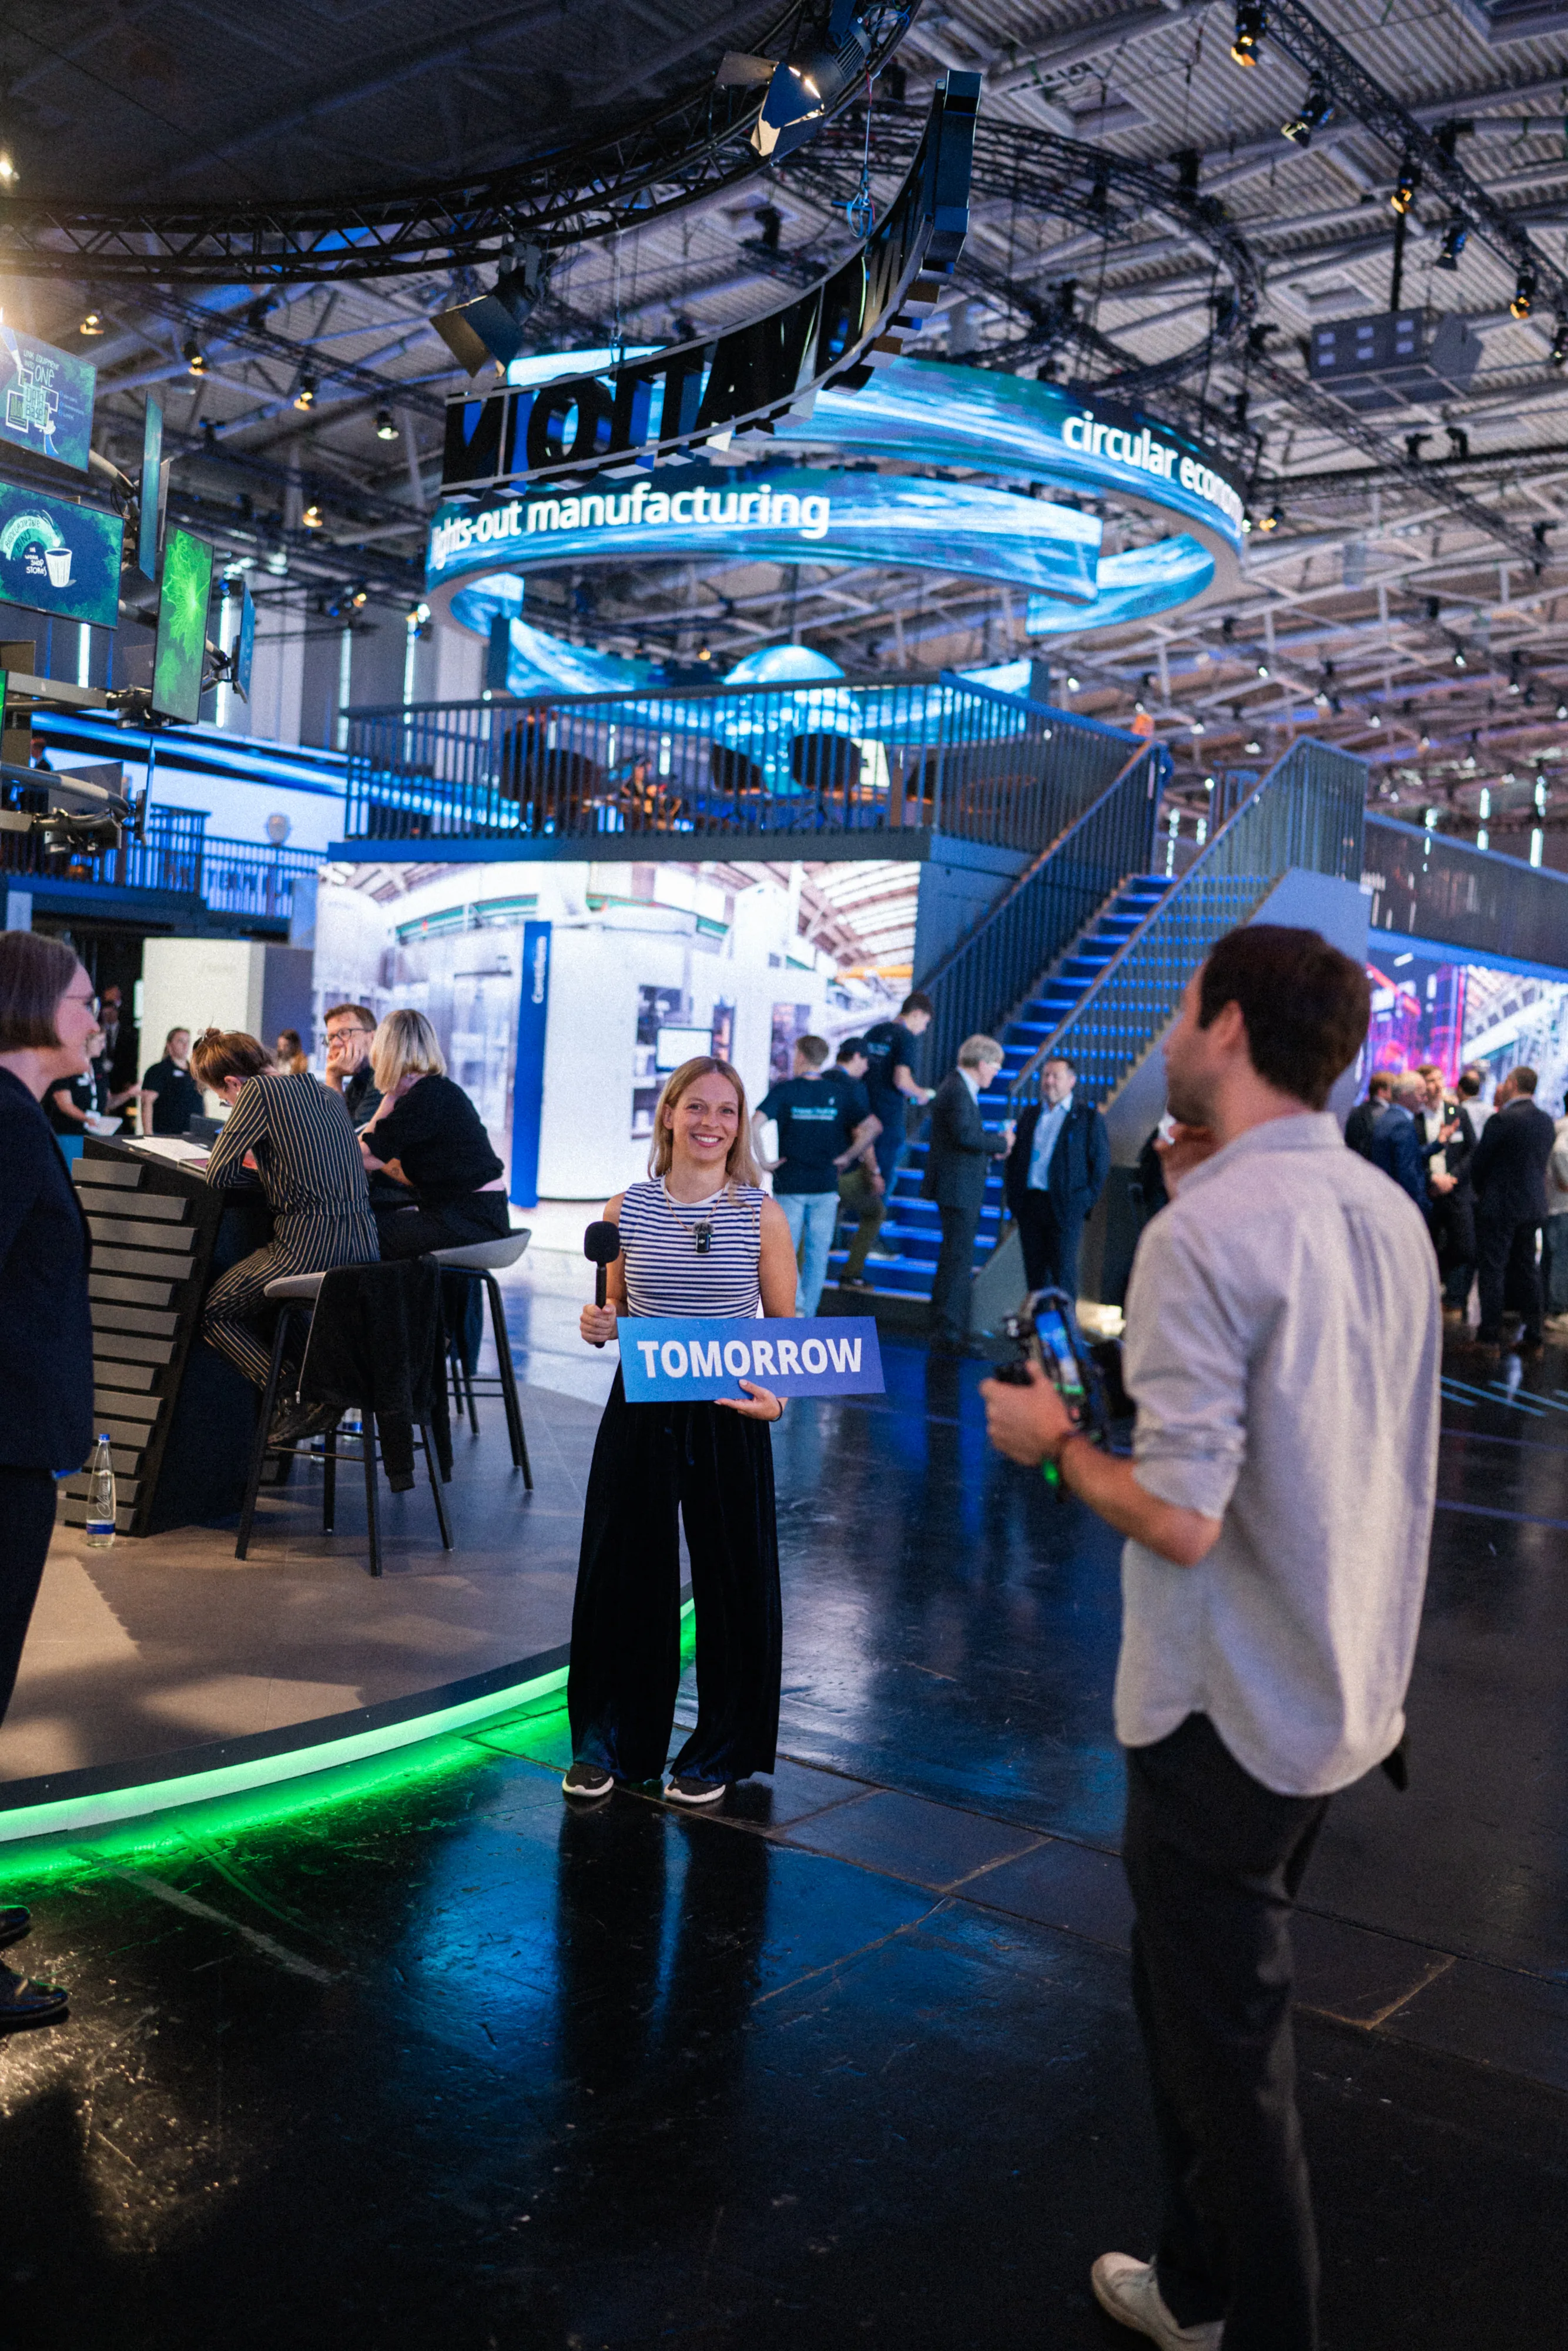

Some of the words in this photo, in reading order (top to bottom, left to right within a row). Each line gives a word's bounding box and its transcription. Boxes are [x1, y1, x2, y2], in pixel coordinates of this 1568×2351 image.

[1061, 410, 1179, 479] circular
[527, 482, 830, 540] manufacturing
[636, 1338, 862, 1379] TOMORROW
